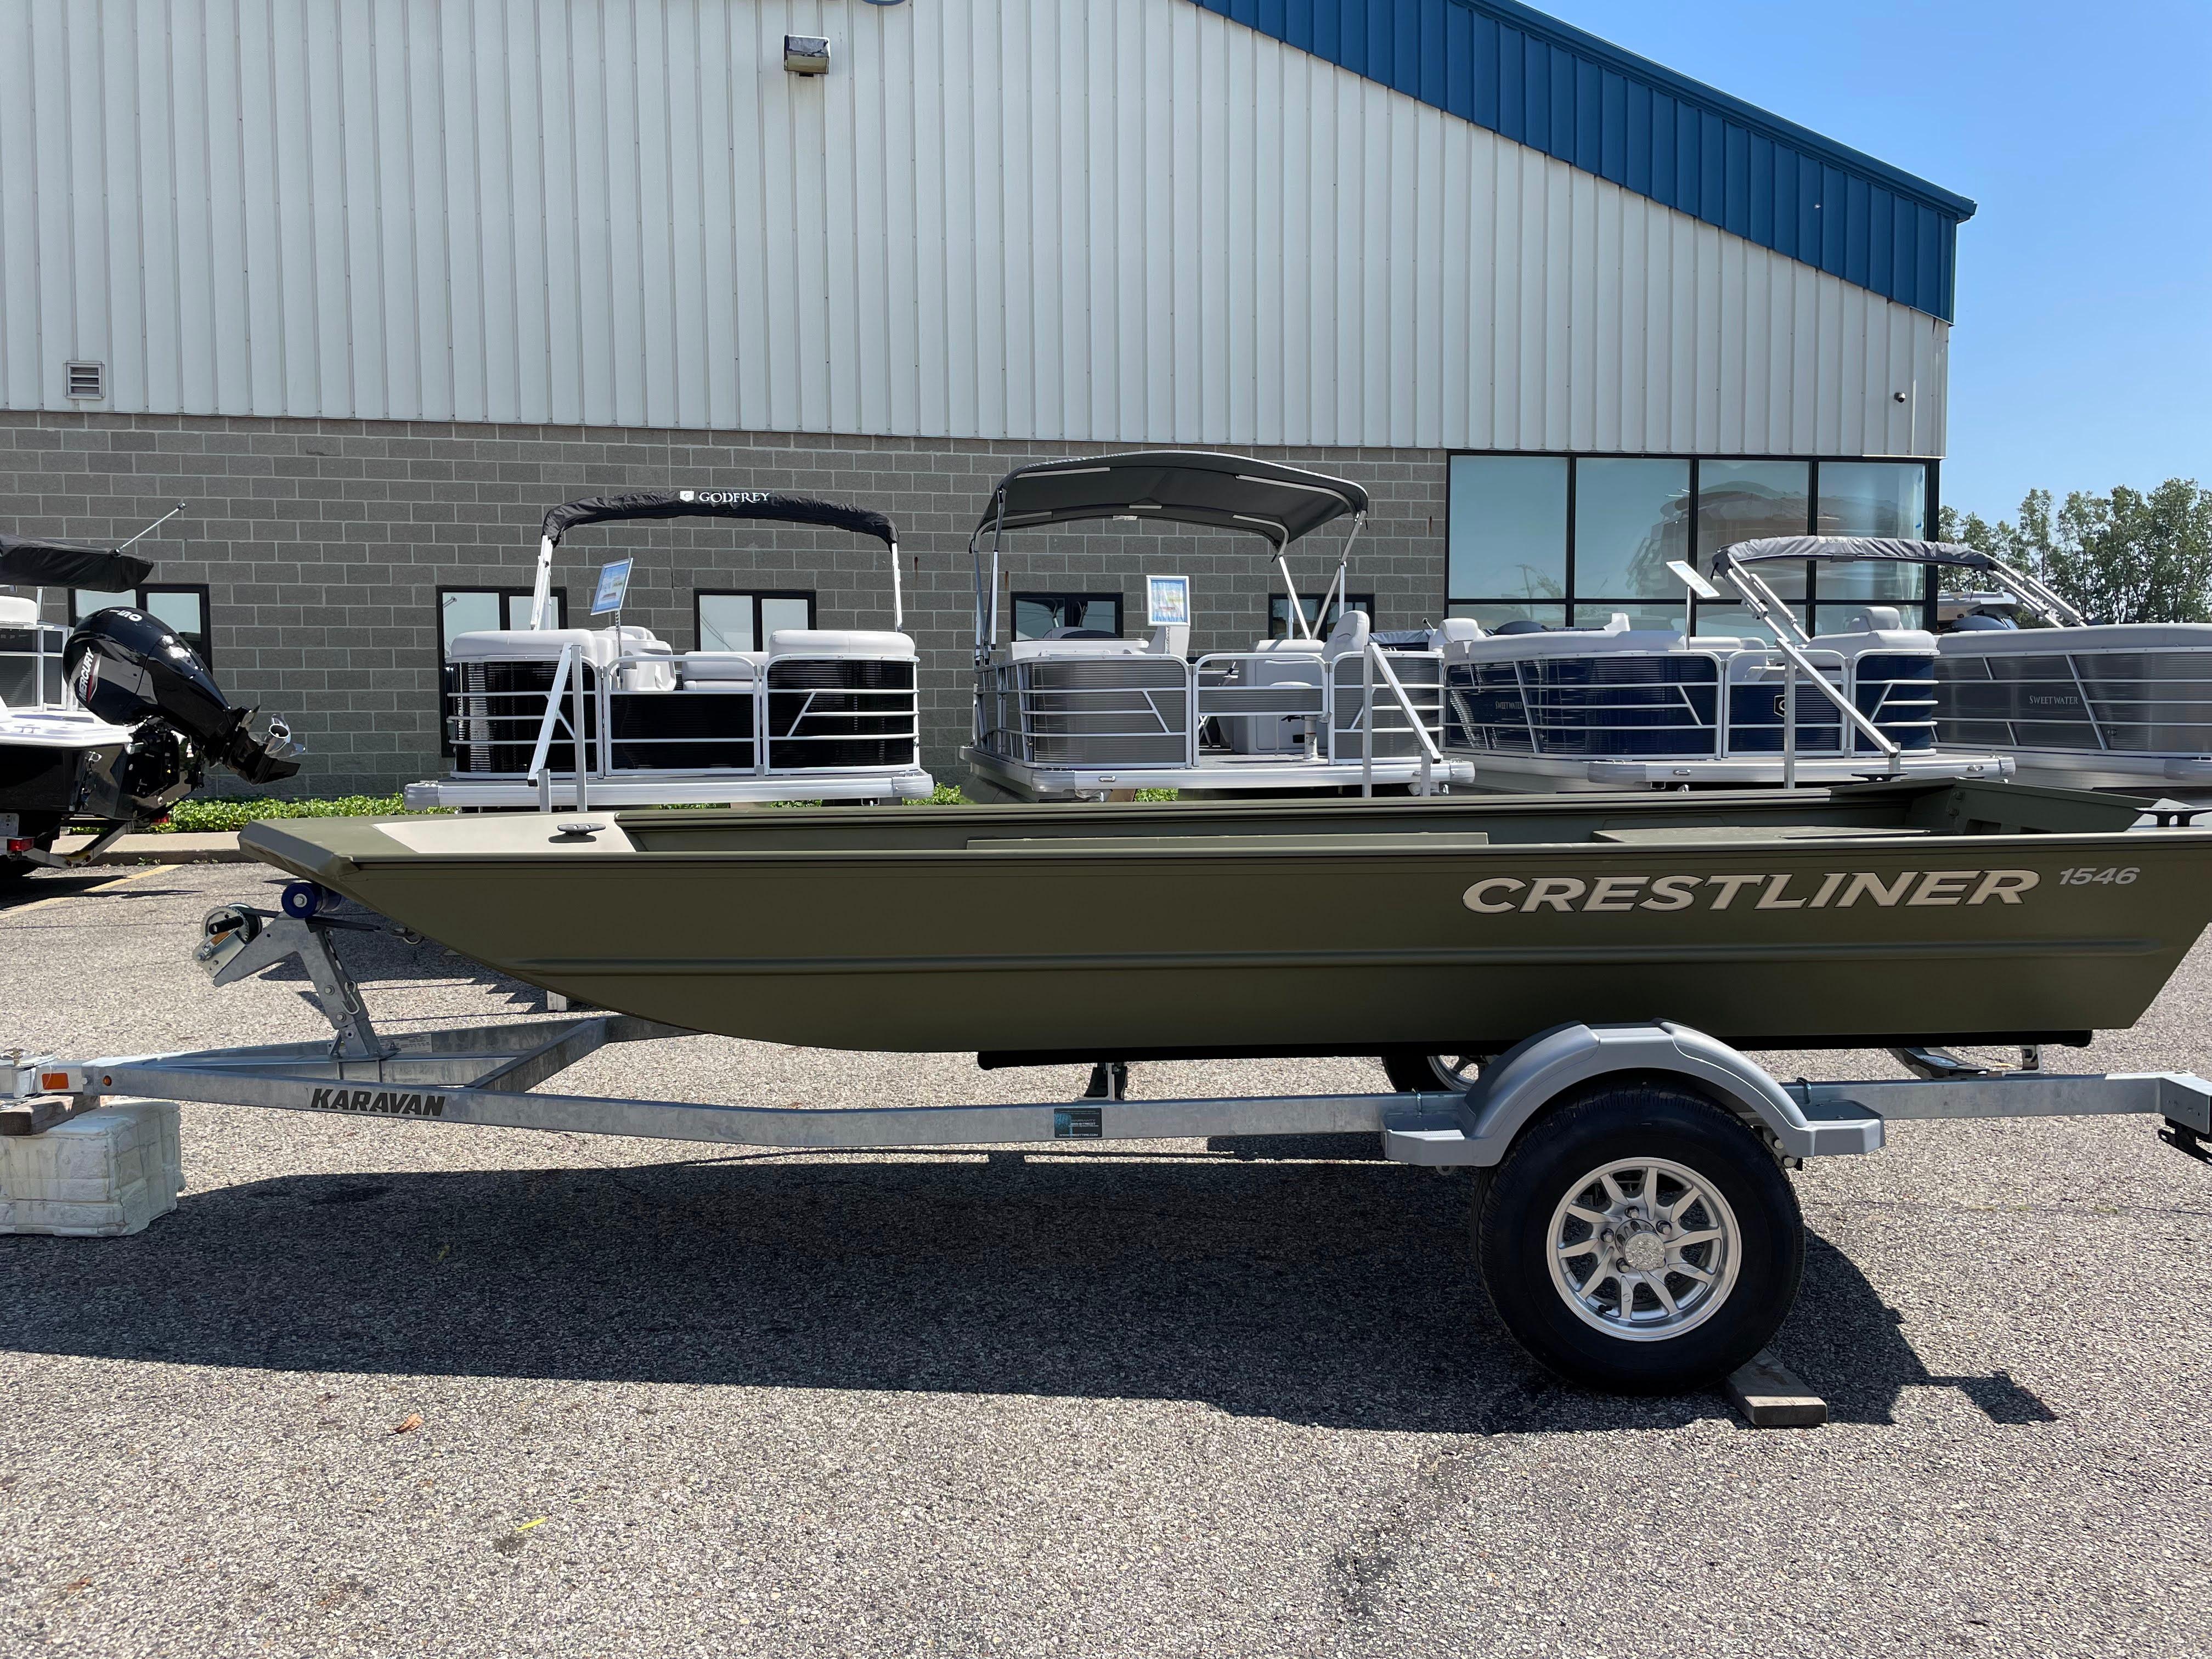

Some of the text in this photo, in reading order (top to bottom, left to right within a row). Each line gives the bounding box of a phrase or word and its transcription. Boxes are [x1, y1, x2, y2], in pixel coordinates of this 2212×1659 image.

[699, 492, 770, 503] GODFREY
[109, 610, 143, 622] 150
[79, 646, 94, 702] MERCURY
[1462, 867, 2140, 914] CRESTLINER 1546
[311, 1088, 445, 1116] KARAVAN
